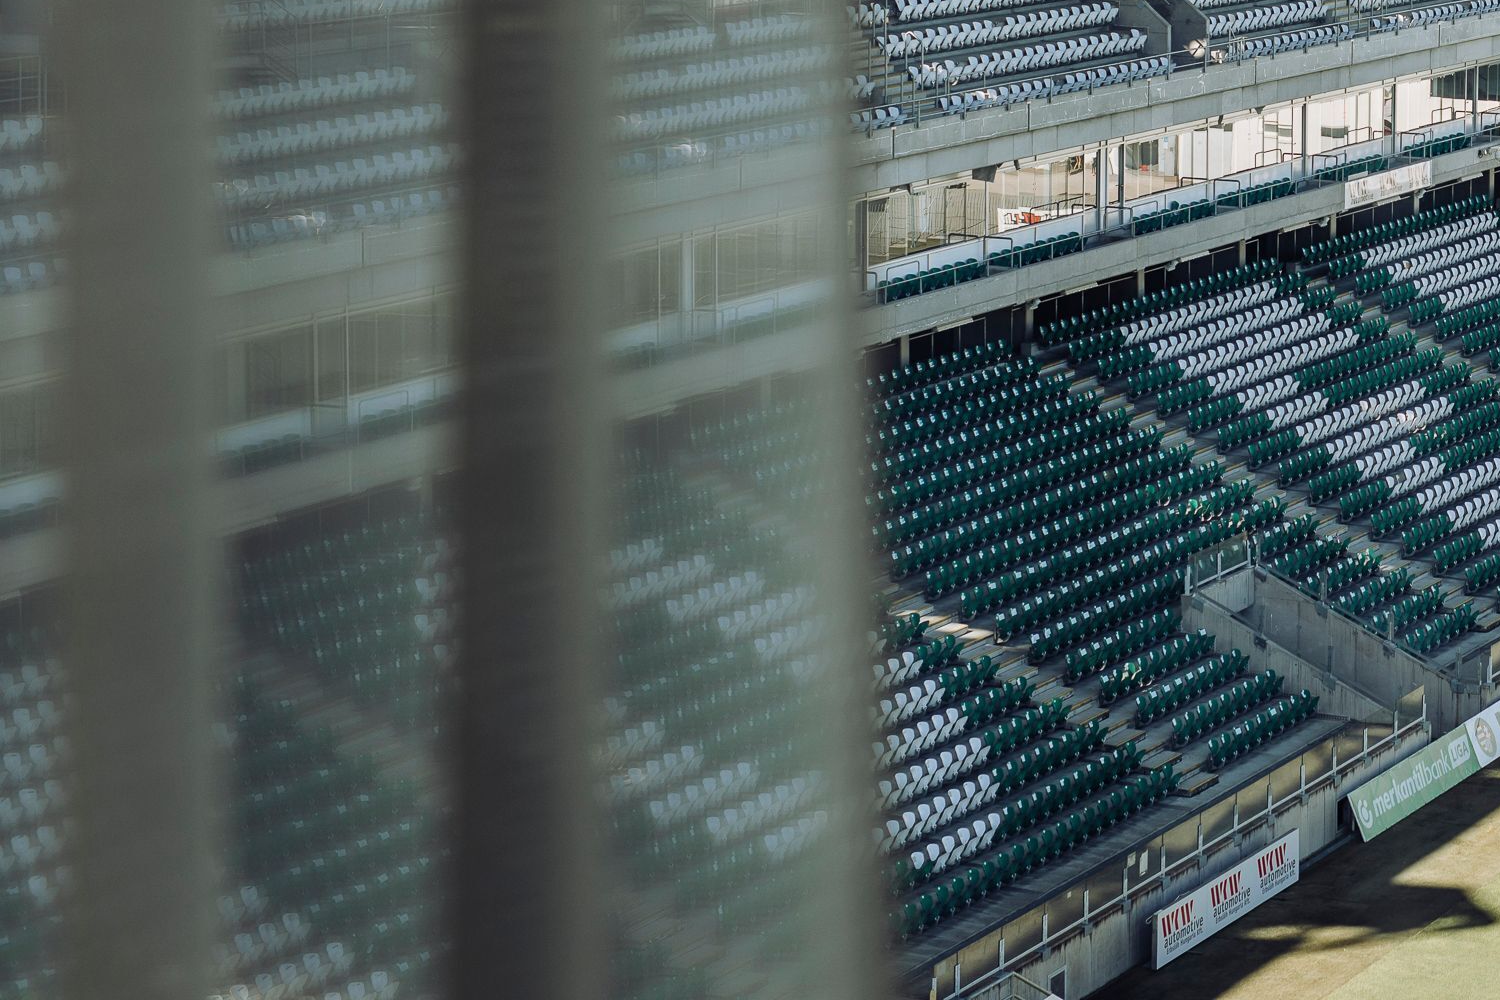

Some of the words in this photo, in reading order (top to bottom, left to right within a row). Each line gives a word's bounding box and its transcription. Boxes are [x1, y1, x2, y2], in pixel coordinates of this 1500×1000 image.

[1373, 749, 1451, 818] merkantilbank
[1450, 740, 1470, 762] LIGA
[1260, 858, 1296, 889] automotive
[1213, 886, 1251, 918] automotive
[1164, 915, 1204, 949] automotive
